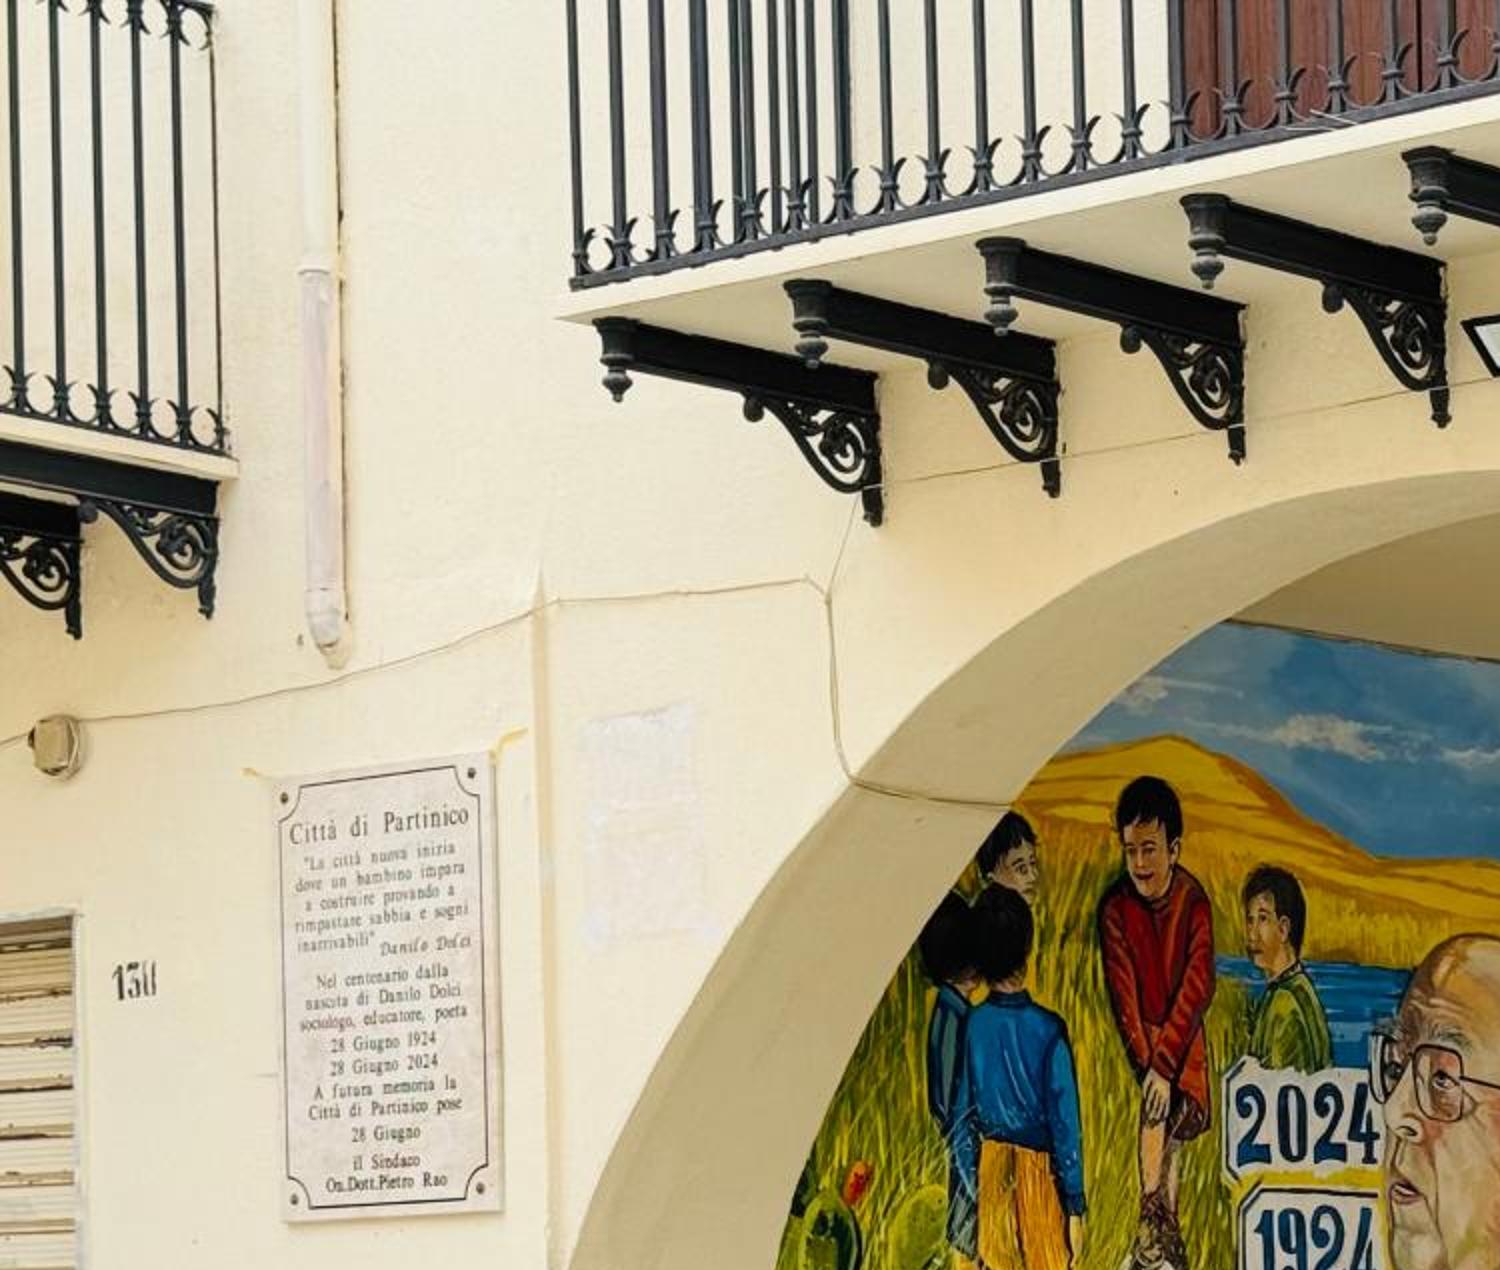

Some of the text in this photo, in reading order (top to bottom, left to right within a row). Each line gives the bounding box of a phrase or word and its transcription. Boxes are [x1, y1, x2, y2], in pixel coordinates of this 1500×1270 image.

[290, 804, 469, 844] Città di Partinico
[333, 851, 361, 868] città
[295, 863, 464, 893] dove un bambino impara
[305, 886, 455, 911] a costruire provando a
[295, 902, 468, 935] rimpastare sabbia e sogni
[381, 934, 471, 957] Danilo Dolci
[317, 964, 448, 989] Nel centenario dalla
[305, 983, 461, 1011] nascita di Danilo Dolci
[435, 1004, 467, 1022] poeta
[331, 1031, 436, 1053] 28 Giugno 1924
[330, 1053, 438, 1076] 28 Giugno 2024
[314, 1075, 456, 1100] A futura memoria la
[308, 1097, 463, 1121] Città di Partinico pose
[351, 1124, 421, 1143] 28 Giugno
[1235, 1082, 1380, 1167] 2024
[371, 1152, 421, 1170] Sindaco
[423, 1172, 447, 1187] Rao
